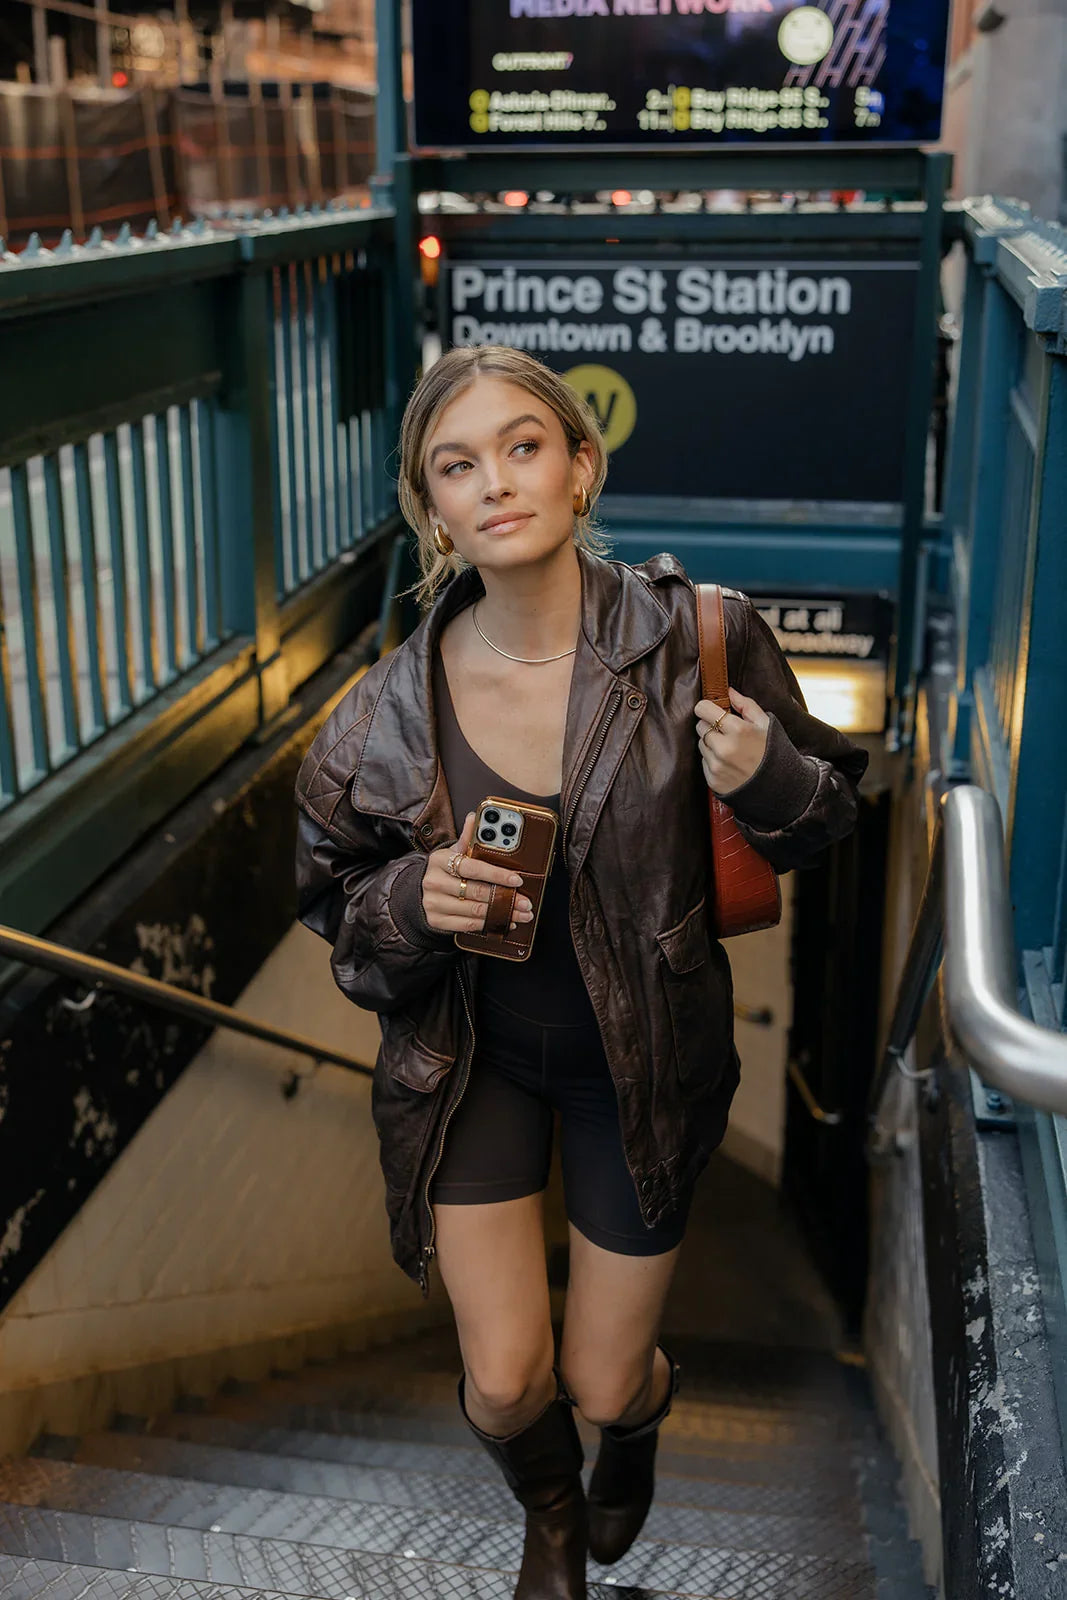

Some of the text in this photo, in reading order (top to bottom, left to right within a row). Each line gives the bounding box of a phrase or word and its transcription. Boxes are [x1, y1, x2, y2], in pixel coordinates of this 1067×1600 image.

[452, 266, 852, 315] Prince St Station
[452, 315, 834, 362] Downtown & Brooklyn
[813, 607, 843, 632] all
